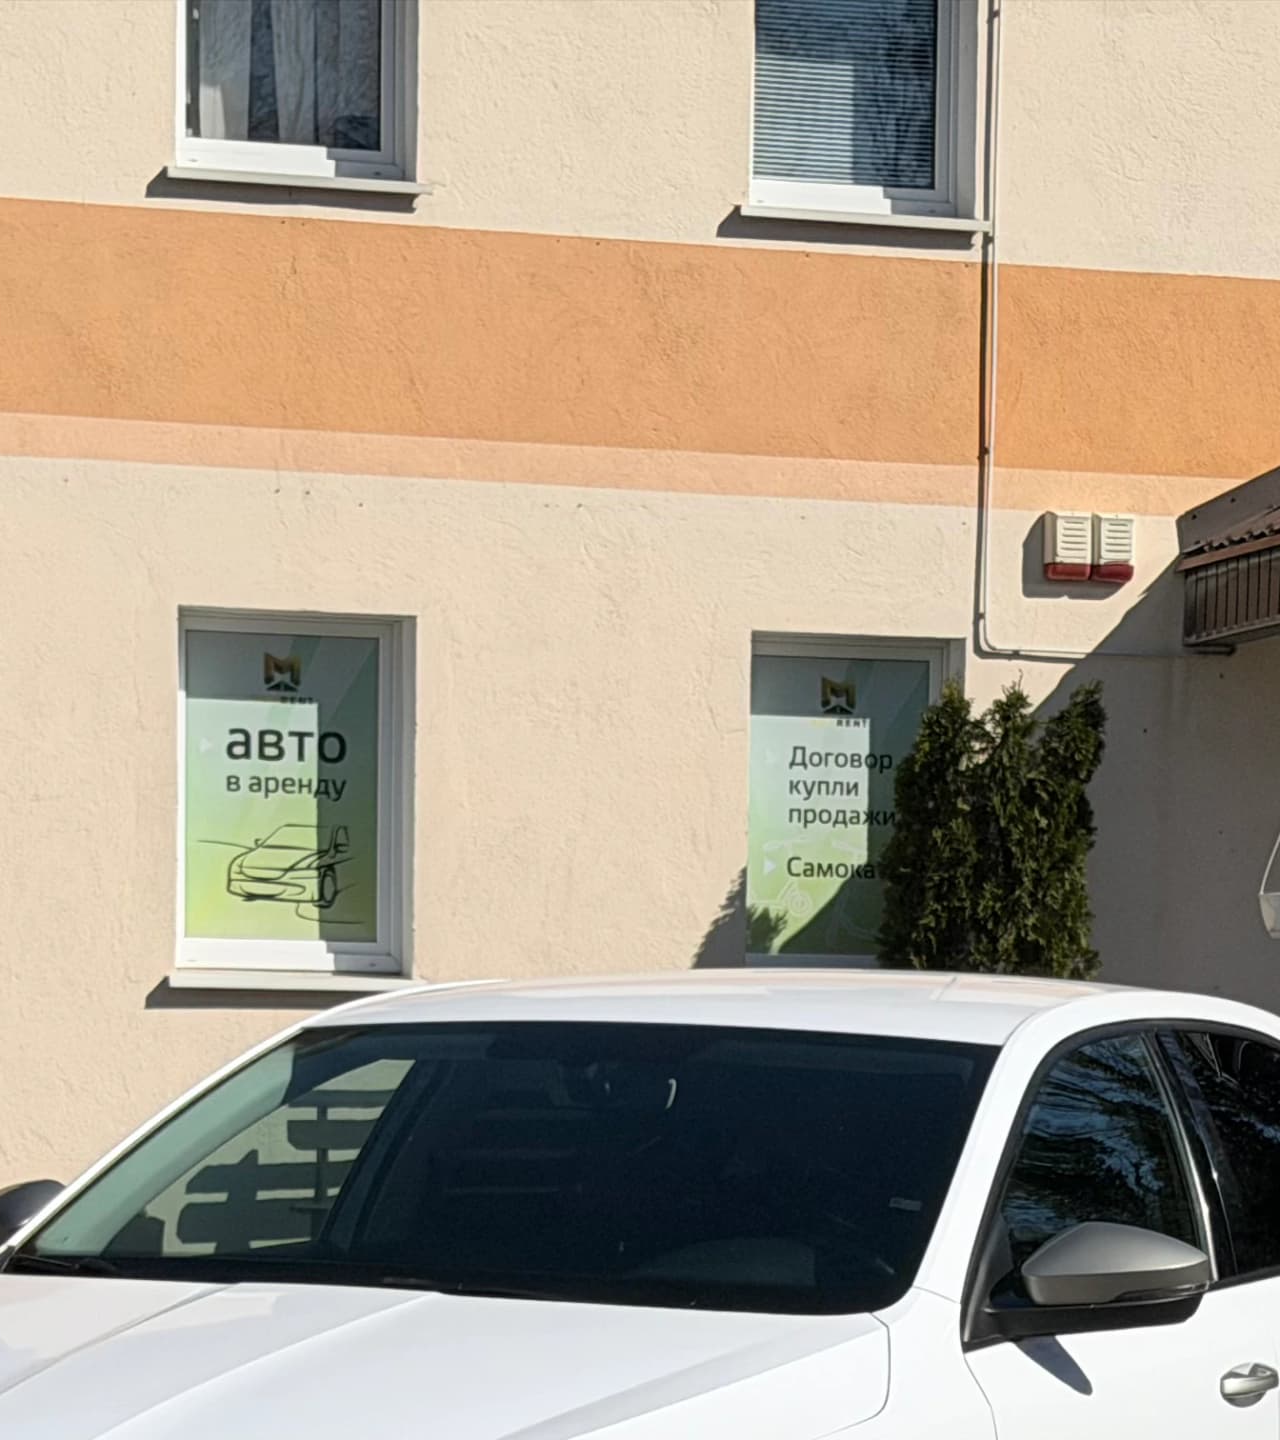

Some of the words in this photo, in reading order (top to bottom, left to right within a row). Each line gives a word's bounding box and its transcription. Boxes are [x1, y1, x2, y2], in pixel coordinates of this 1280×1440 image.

[225, 728, 347, 764] авто
[789, 745, 893, 774] Договор
[225, 774, 241, 792] в
[248, 776, 347, 801] аренду
[789, 779, 859, 801] купли
[789, 807, 896, 829] продажи
[786, 856, 876, 879] Самока
